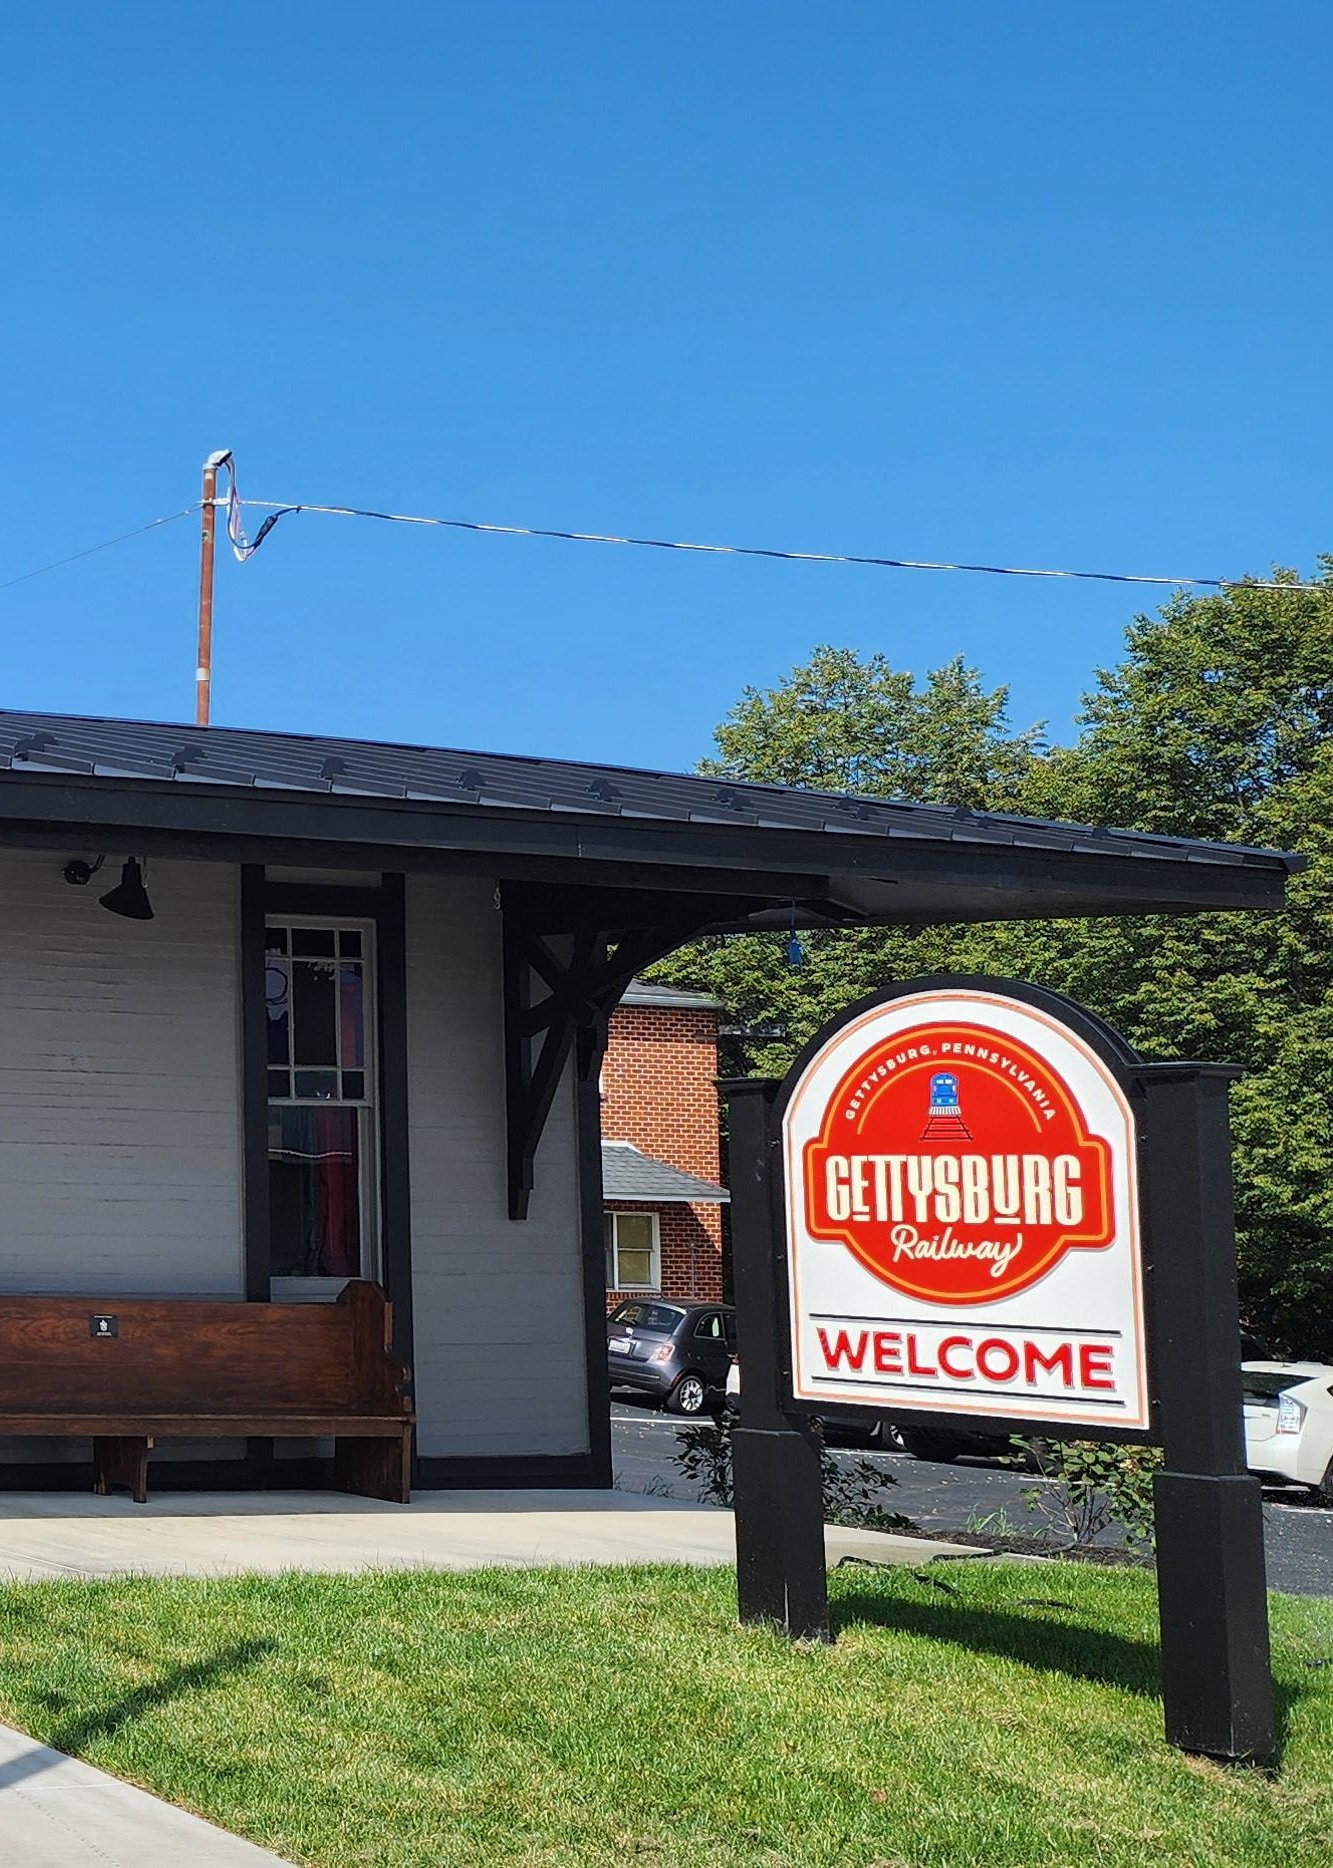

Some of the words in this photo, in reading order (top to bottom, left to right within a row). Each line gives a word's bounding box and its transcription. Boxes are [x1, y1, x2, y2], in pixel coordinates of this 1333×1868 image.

[844, 1044, 938, 1121] GETTYSBURG,
[942, 1042, 1056, 1121] PENNSYLVANIA
[825, 1154, 1083, 1226] GETTYSBURG
[890, 1223, 1024, 1278] Railway
[816, 1326, 1118, 1392] WELCOME
